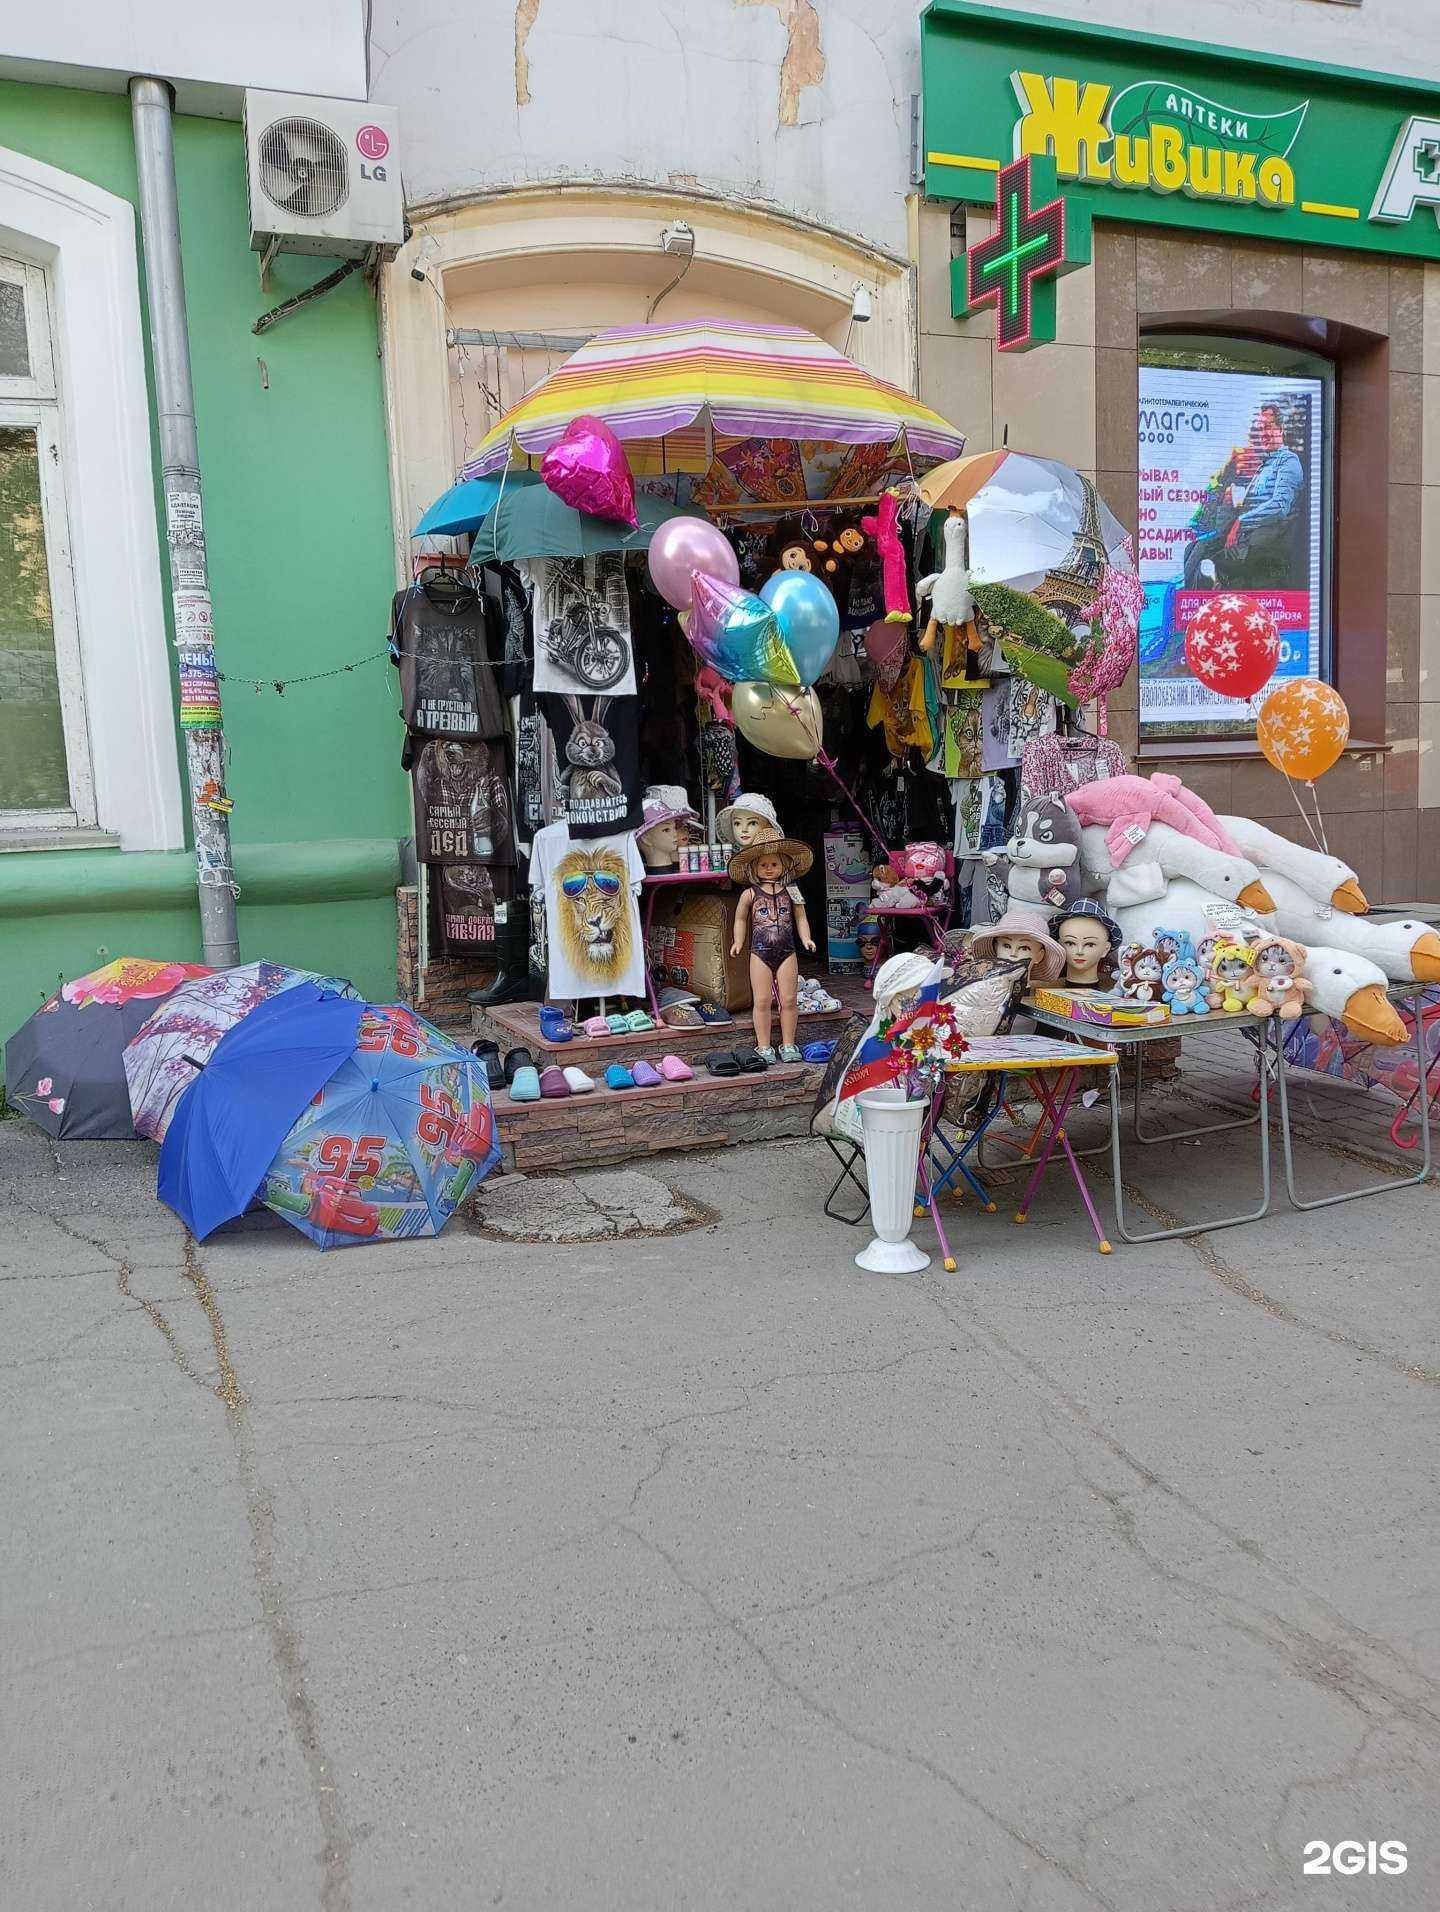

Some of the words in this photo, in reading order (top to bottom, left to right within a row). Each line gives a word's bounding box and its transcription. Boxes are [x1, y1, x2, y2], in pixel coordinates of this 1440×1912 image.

[1165, 93, 1249, 140] АПТЕКИ
[1012, 70, 1295, 207] Живика
[360, 163, 387, 182] LG
[1138, 397, 1210, 409] ГНИТОТЕРАПЕВТИЧЕСКИЙ
[1167, 489, 1209, 503] СЕЗОН
[1138, 547, 1173, 561] АВЫ!
[1181, 598, 1200, 610] ДЛЯ
[428, 699, 437, 710] НЕ
[417, 709, 424, 728] Я
[425, 711, 478, 732] ТРЕЗВЫЙ
[429, 805, 461, 818] САМЫЙ
[430, 830, 469, 857] ДЕД
[316, 1135, 386, 1181] 95
